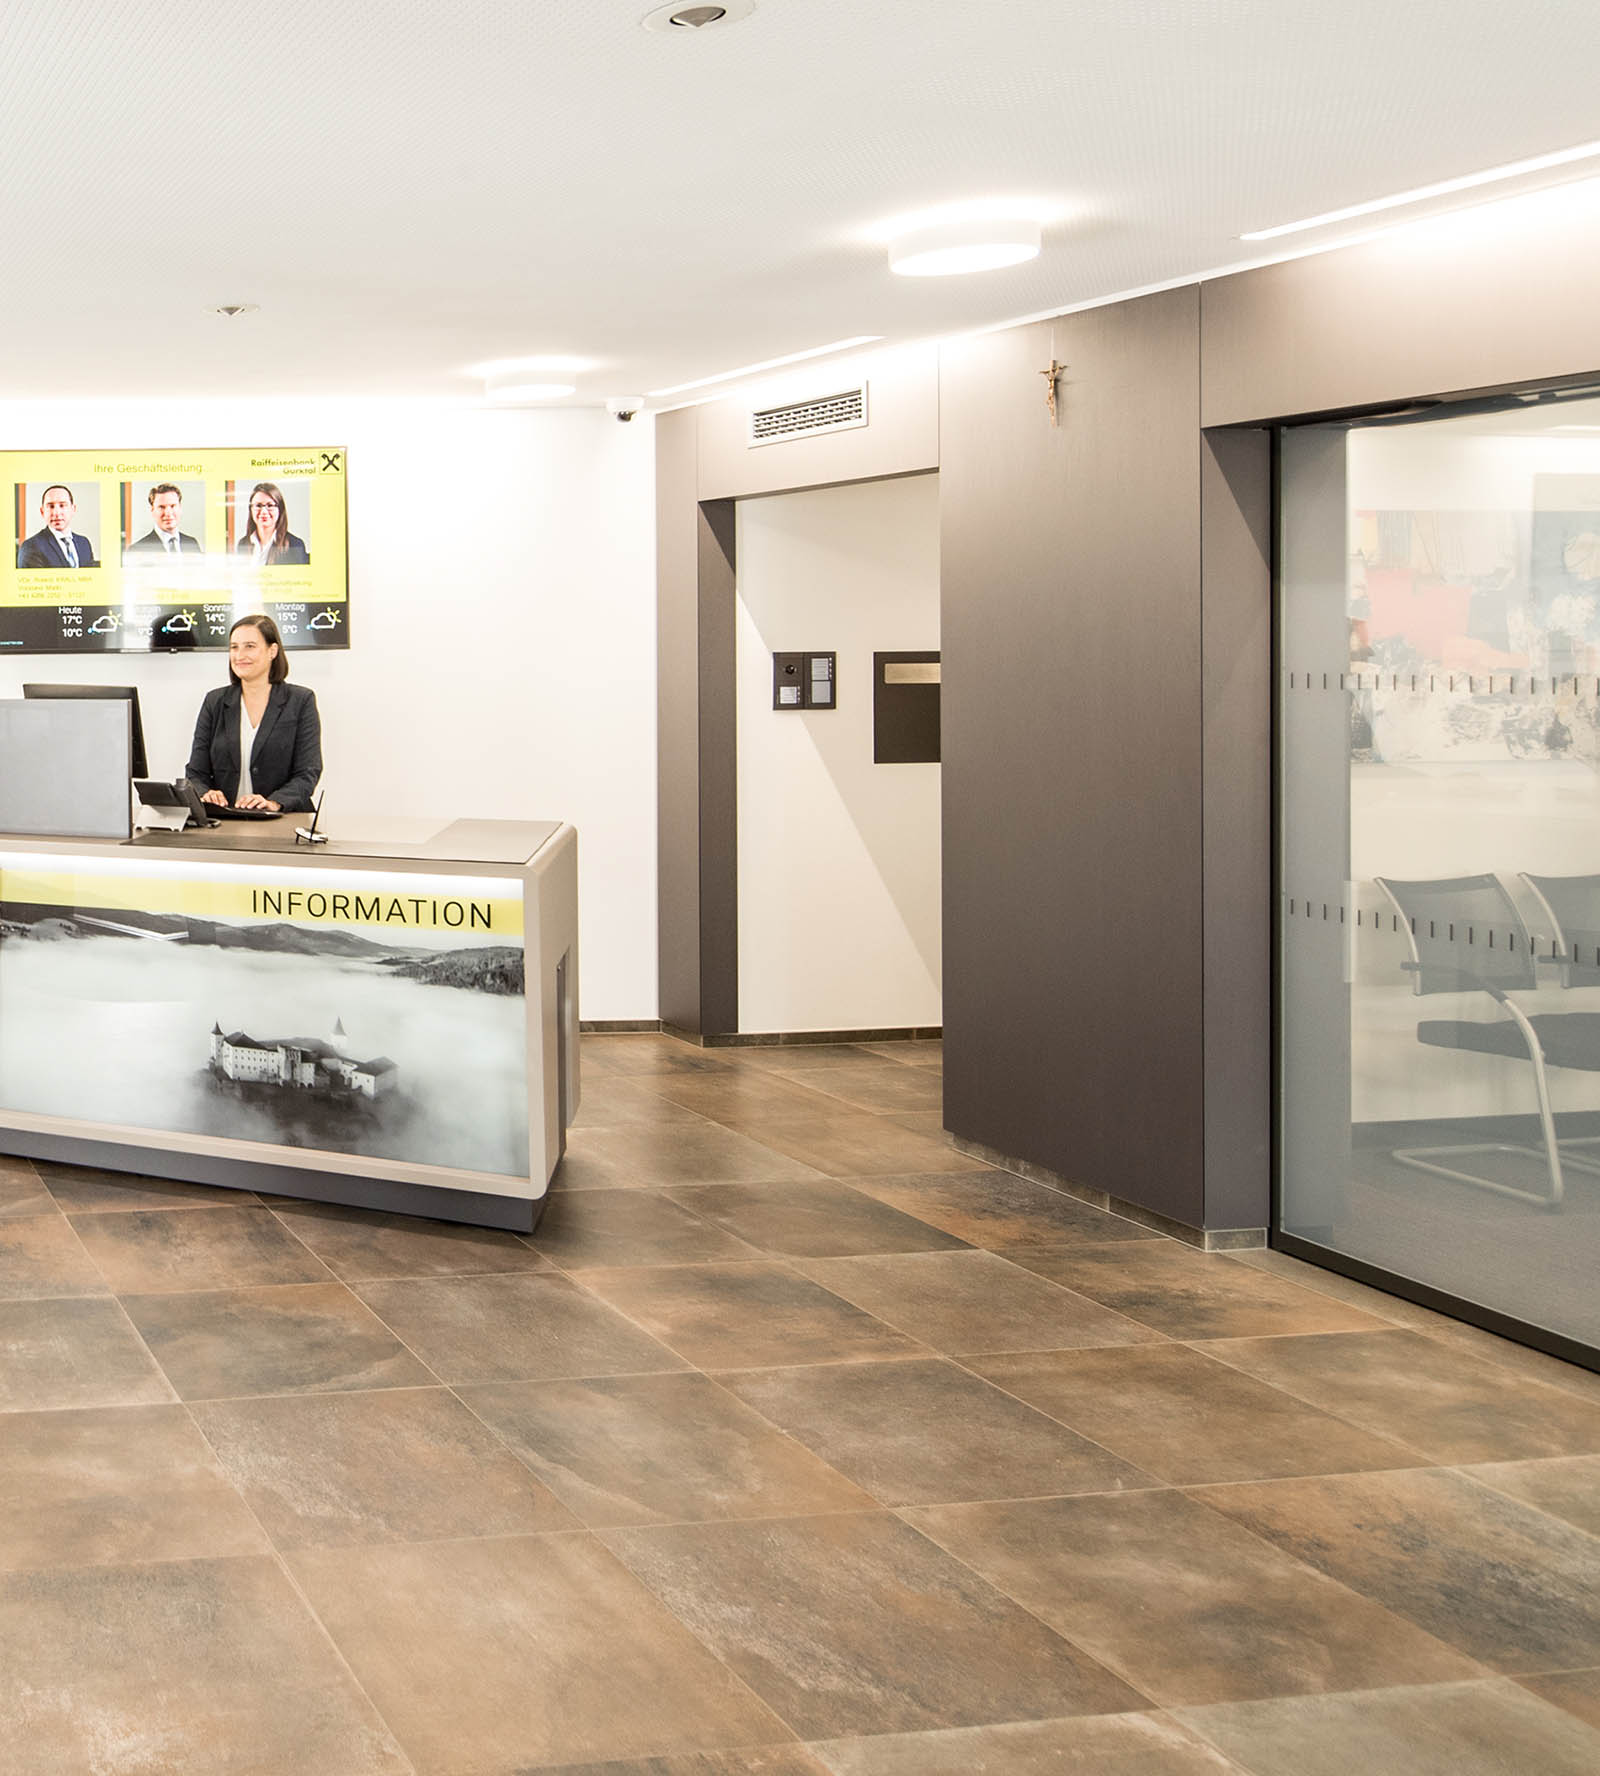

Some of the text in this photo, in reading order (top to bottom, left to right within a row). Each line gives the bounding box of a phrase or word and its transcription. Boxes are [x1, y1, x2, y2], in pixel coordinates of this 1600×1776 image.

[251, 458, 315, 467] Raiffeisenbank
[94, 463, 203, 474] Ihre Geschäftsleitung
[58, 606, 82, 615] Heute
[275, 604, 305, 613] Montag
[62, 615, 83, 625] 17°C
[205, 613, 225, 623] 14°C
[277, 612, 298, 622] 15°C
[62, 628, 83, 637] 10°C
[209, 625, 225, 635] 7°C
[283, 625, 298, 634] 5°C
[252, 889, 492, 929] INFORMATION
